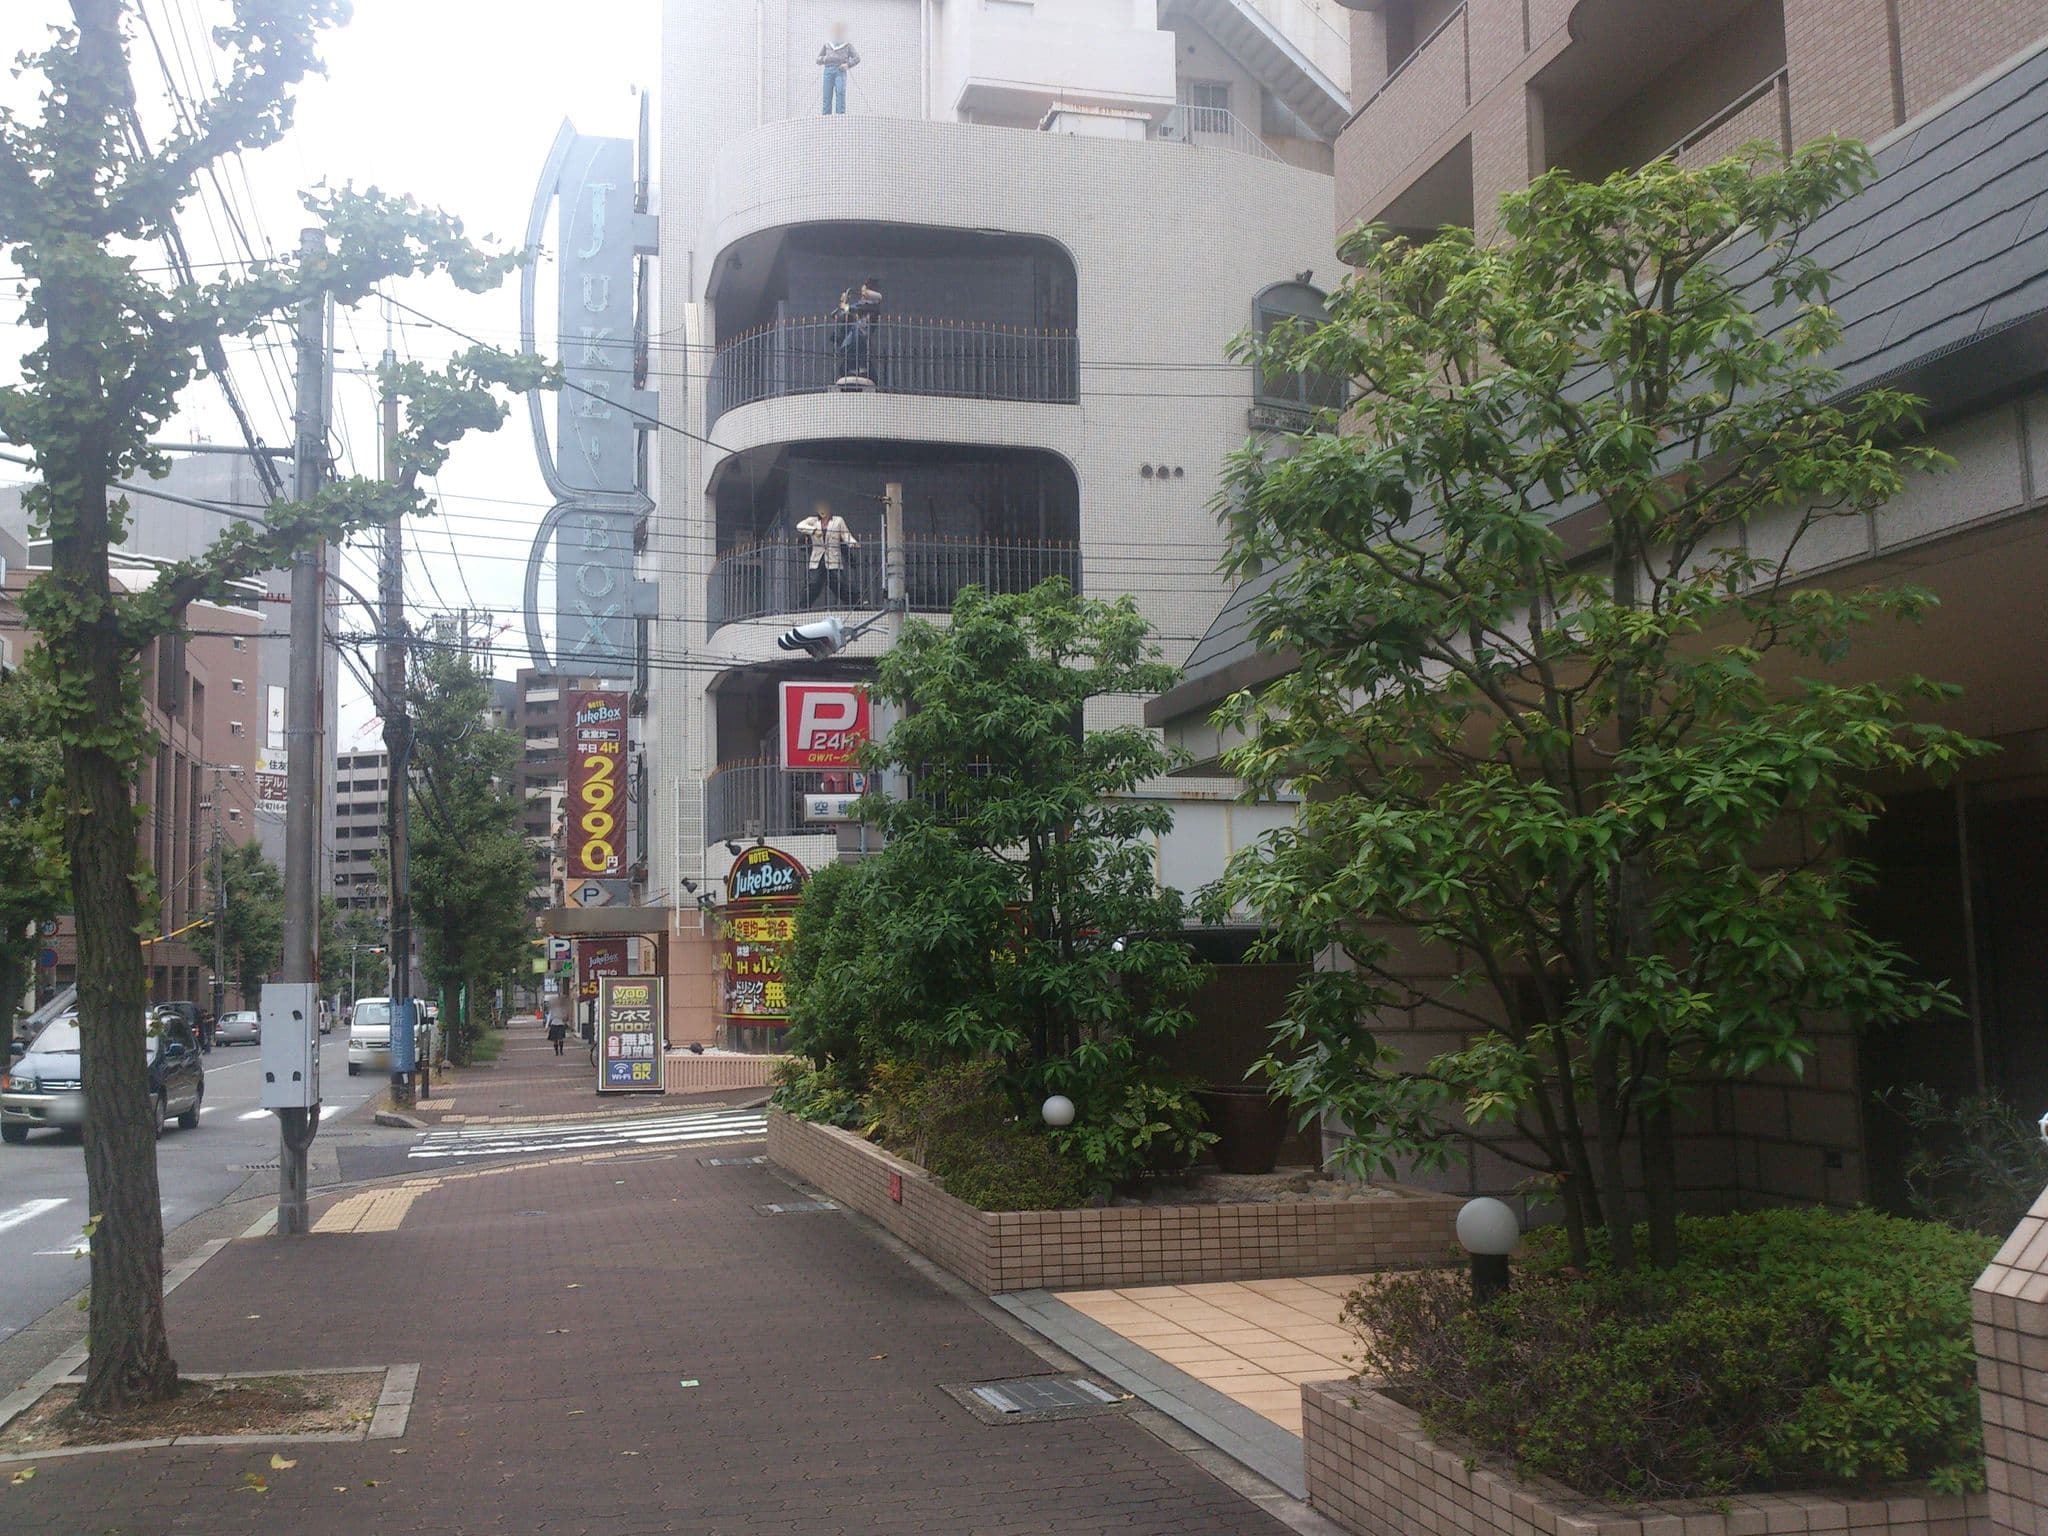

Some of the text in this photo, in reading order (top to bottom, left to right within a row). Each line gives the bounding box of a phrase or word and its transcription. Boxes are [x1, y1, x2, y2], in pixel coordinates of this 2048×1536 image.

[571, 513, 620, 658] BOX
[576, 707, 620, 727] JukeBox
[797, 692, 859, 750] P
[578, 742, 619, 754] 平日 4H
[749, 850, 770, 865] HOTEL
[735, 864, 793, 899] JukeBox
[583, 888, 600, 902] P
[550, 939, 570, 959] P
[736, 961, 749, 975] 1H
[614, 988, 647, 999] VOD
[736, 981, 764, 995] ドリンク
[736, 996, 760, 1008] フード
[610, 1010, 650, 1021] シネマ
[632, 1071, 651, 1081] OK
